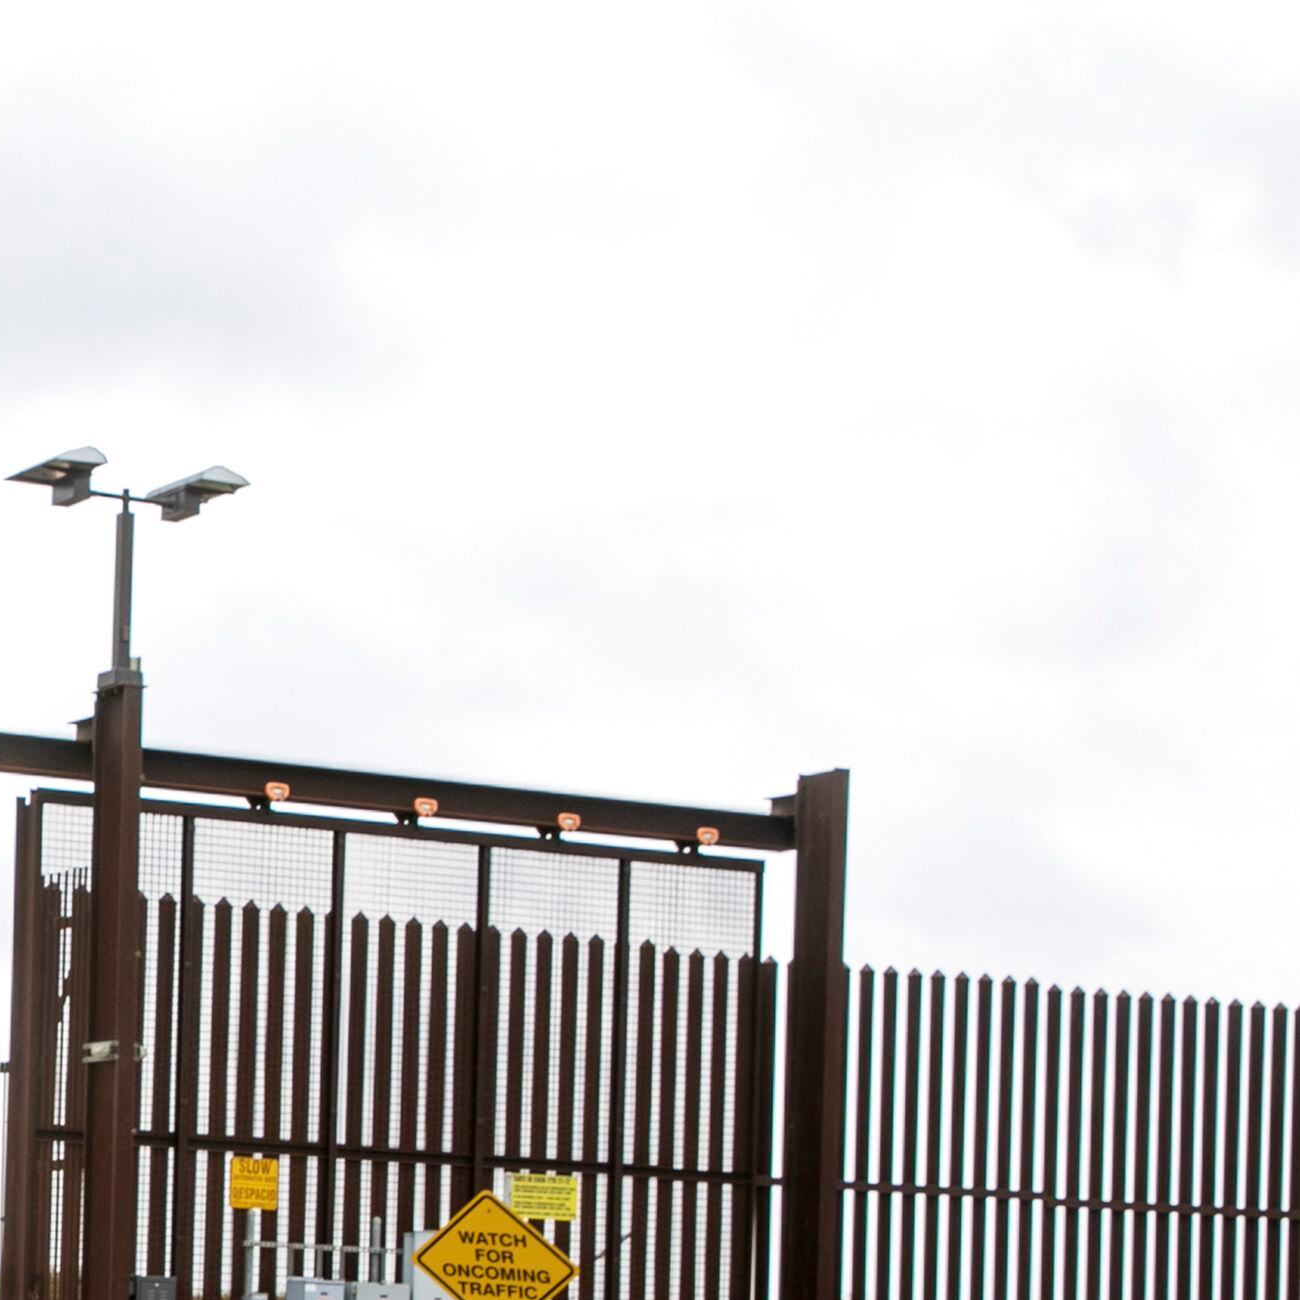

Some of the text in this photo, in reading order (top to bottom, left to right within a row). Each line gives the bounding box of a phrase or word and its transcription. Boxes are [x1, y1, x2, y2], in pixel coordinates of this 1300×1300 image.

[239, 1159, 272, 1174] SLOW
[233, 1187, 276, 1201] DESPACIO
[458, 1230, 527, 1248] WATCH
[475, 1249, 514, 1264] FOR
[442, 1263, 551, 1284] ONCOMING
[458, 1281, 538, 1300] TRAFFIC
